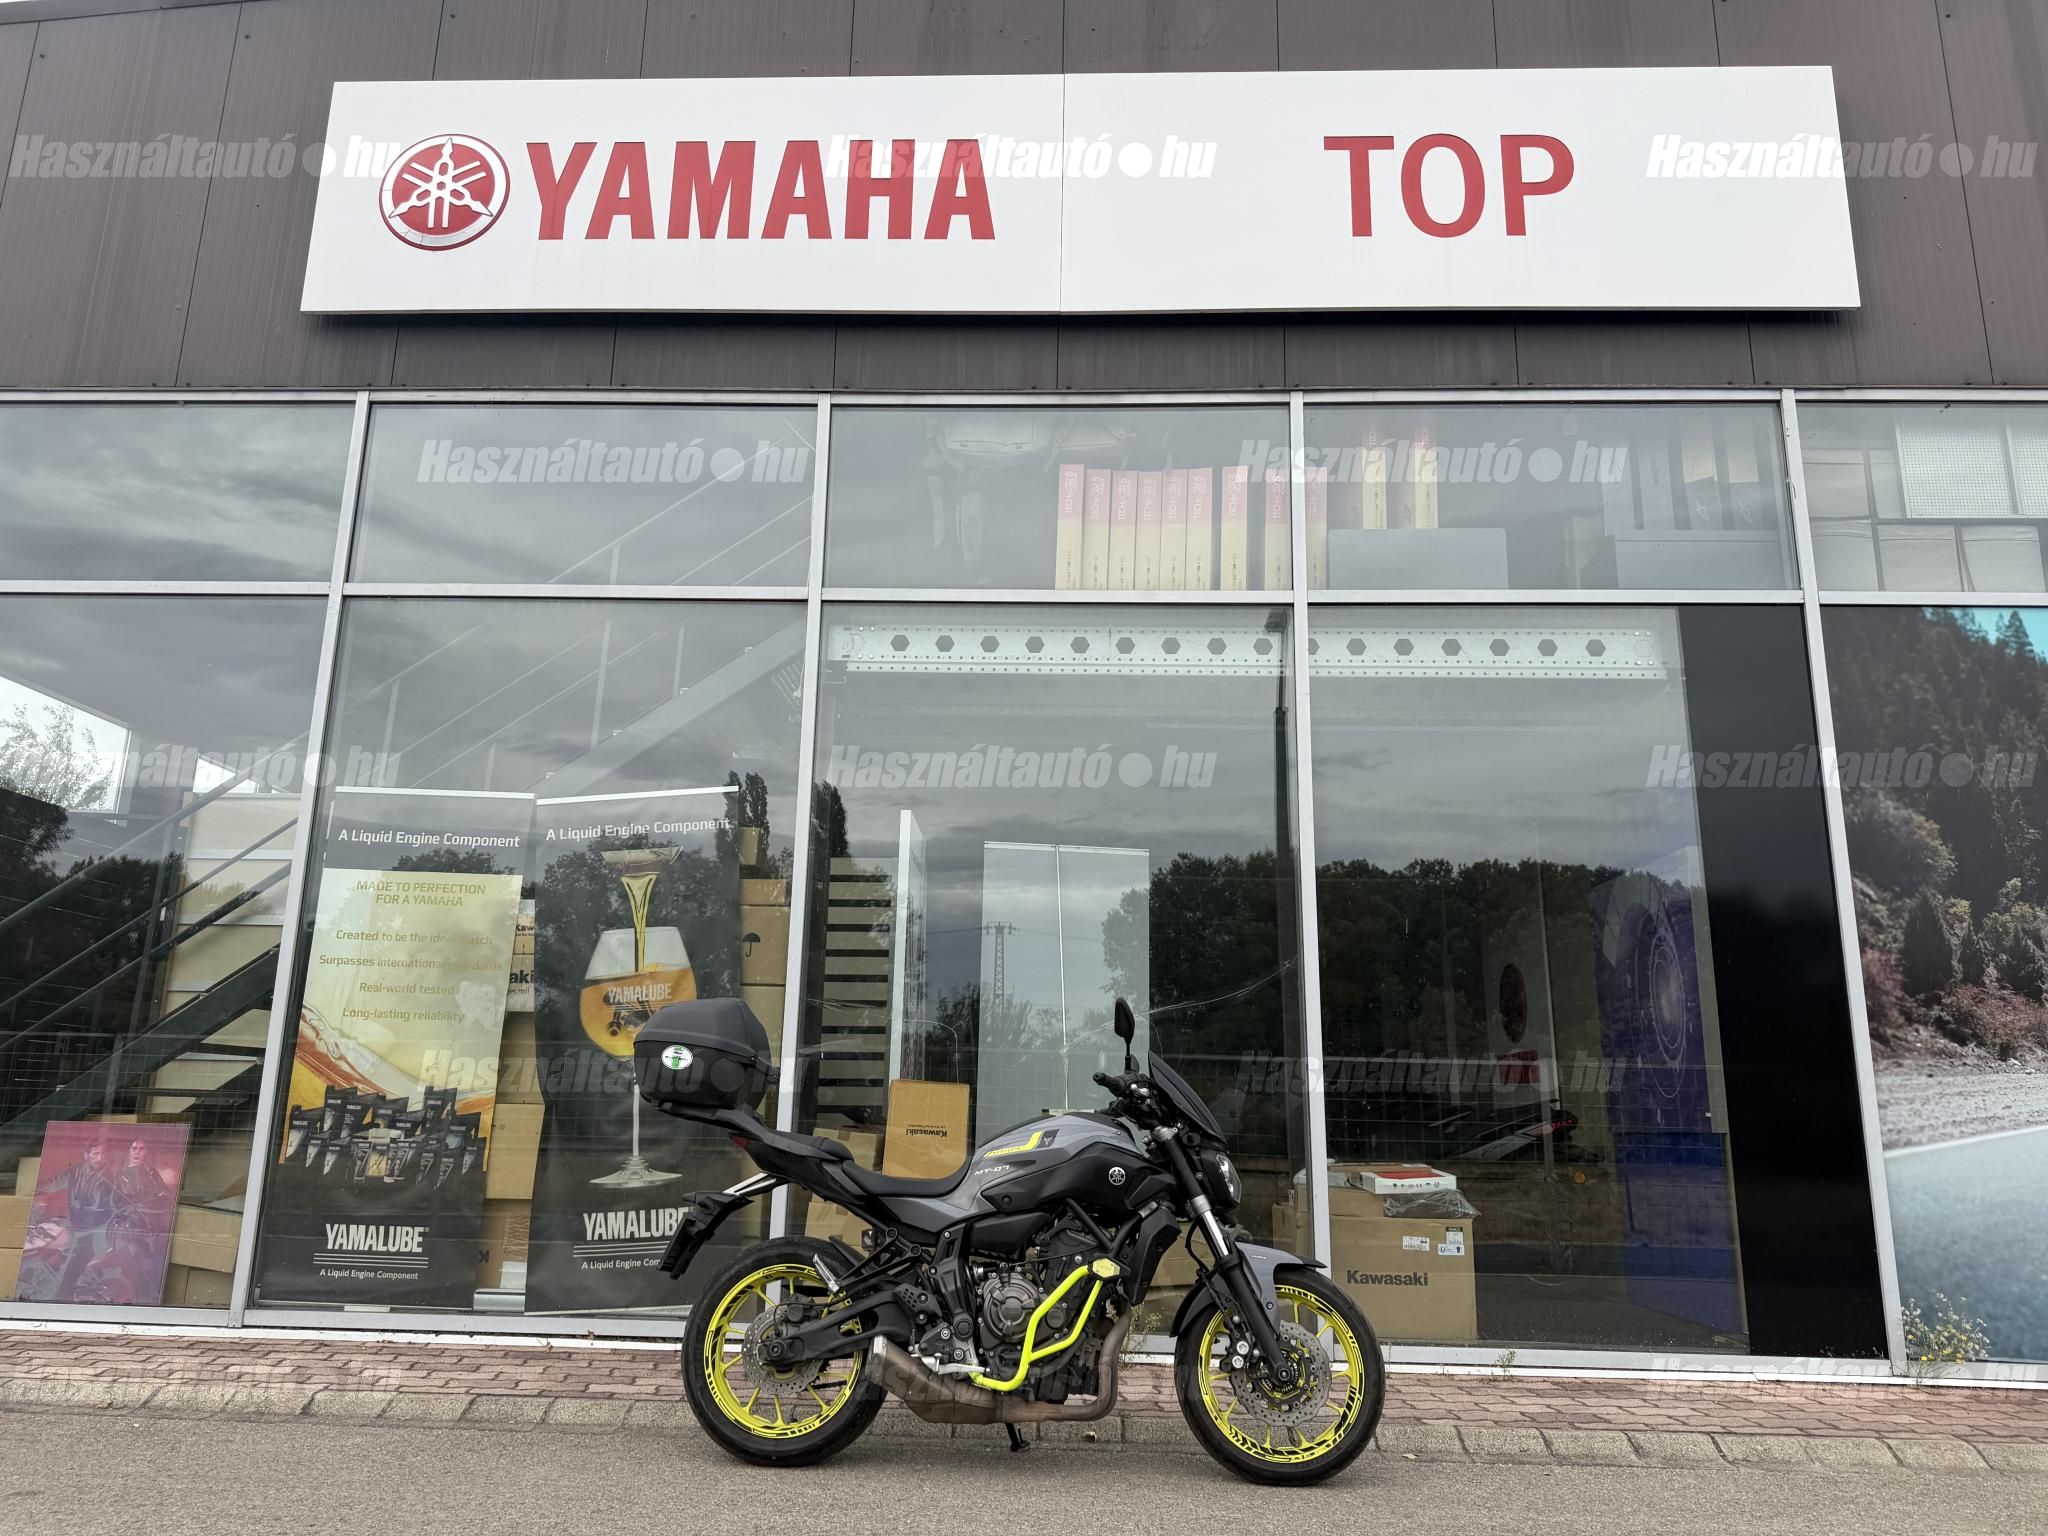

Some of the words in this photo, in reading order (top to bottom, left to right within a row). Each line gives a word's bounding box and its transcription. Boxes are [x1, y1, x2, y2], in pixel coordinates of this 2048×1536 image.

[526, 140, 995, 240] YAMAHA
[1323, 133, 1575, 238] TOP
[546, 829, 556, 841] A
[560, 825, 601, 842] Liquid
[605, 823, 650, 839] Engine
[654, 818, 730, 835] Component
[338, 829, 348, 841] A
[351, 829, 392, 845] Liquid
[396, 831, 440, 847] Engine
[444, 832, 520, 849] Component
[356, 880, 392, 891] MADE
[395, 881, 410, 891] TO
[413, 882, 486, 895] PERFECTION
[376, 894, 400, 905] FOR
[402, 895, 410, 905] A
[414, 895, 463, 906] YAMAHA
[336, 930, 379, 942] Created
[382, 932, 392, 942] to
[319, 955, 375, 967] Surpasses
[359, 982, 416, 994] Real-world
[420, 984, 455, 995] tested
[608, 983, 672, 1004] YAMALUBE
[343, 1007, 410, 1022] Long-lasting
[413, 1010, 464, 1024] reliability
[974, 1165, 1010, 1176] MT-07
[590, 1259, 614, 1271] Liquid
[616, 1258, 641, 1269] Engine
[328, 1268, 350, 1279] Liquid
[351, 1269, 375, 1280] Engine
[377, 1270, 419, 1281] Component
[1347, 1271, 1428, 1286] Kawasaki
